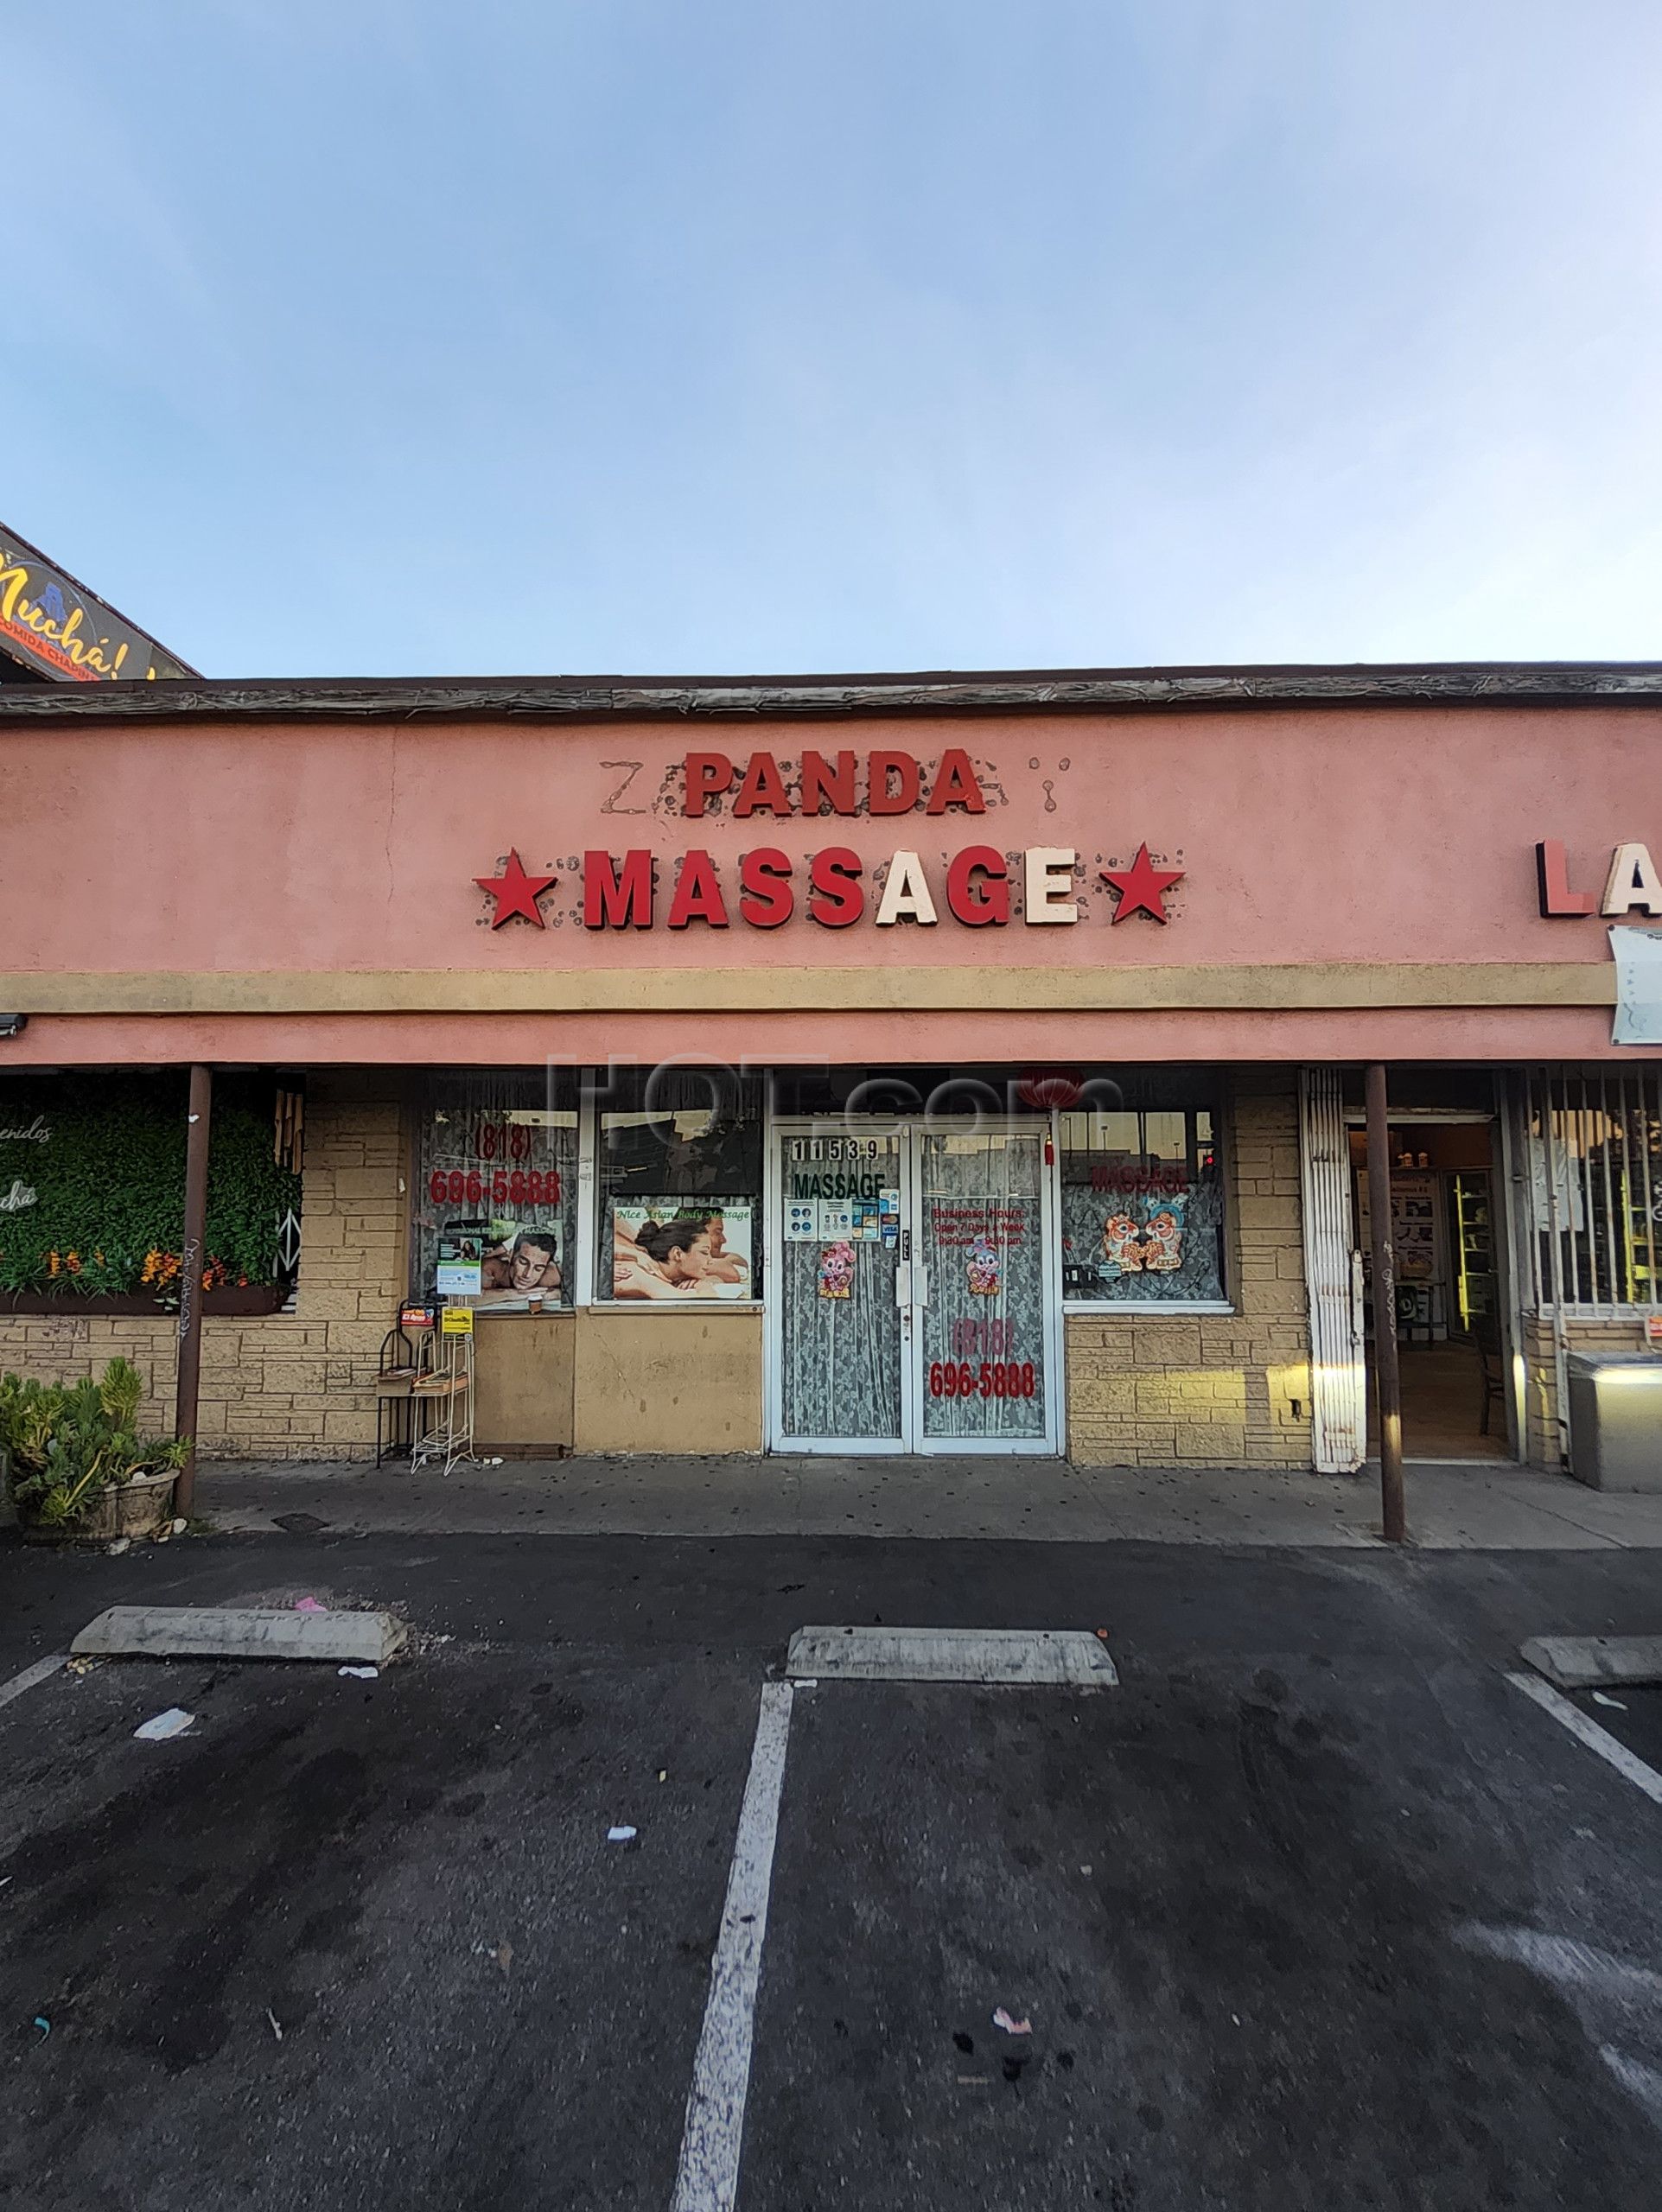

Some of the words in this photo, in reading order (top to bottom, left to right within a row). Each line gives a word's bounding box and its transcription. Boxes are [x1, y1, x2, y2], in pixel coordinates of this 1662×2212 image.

[684, 748, 986, 819] PANDA
[583, 846, 1079, 931] MASSAGE
[1535, 840, 1662, 918] LA
[474, 1123, 532, 1160] (818)
[793, 1140, 878, 1160] 11539
[430, 1170, 561, 1205] 696-5888
[793, 1173, 886, 1200] MASSAGE
[1092, 1166, 1190, 1193] MASSAGE
[933, 1208, 985, 1218] Business
[934, 1223, 958, 1233] Open
[1001, 1223, 1025, 1232] Week
[952, 1318, 1014, 1357] (818)
[930, 1362, 1035, 1397] 696-5888
